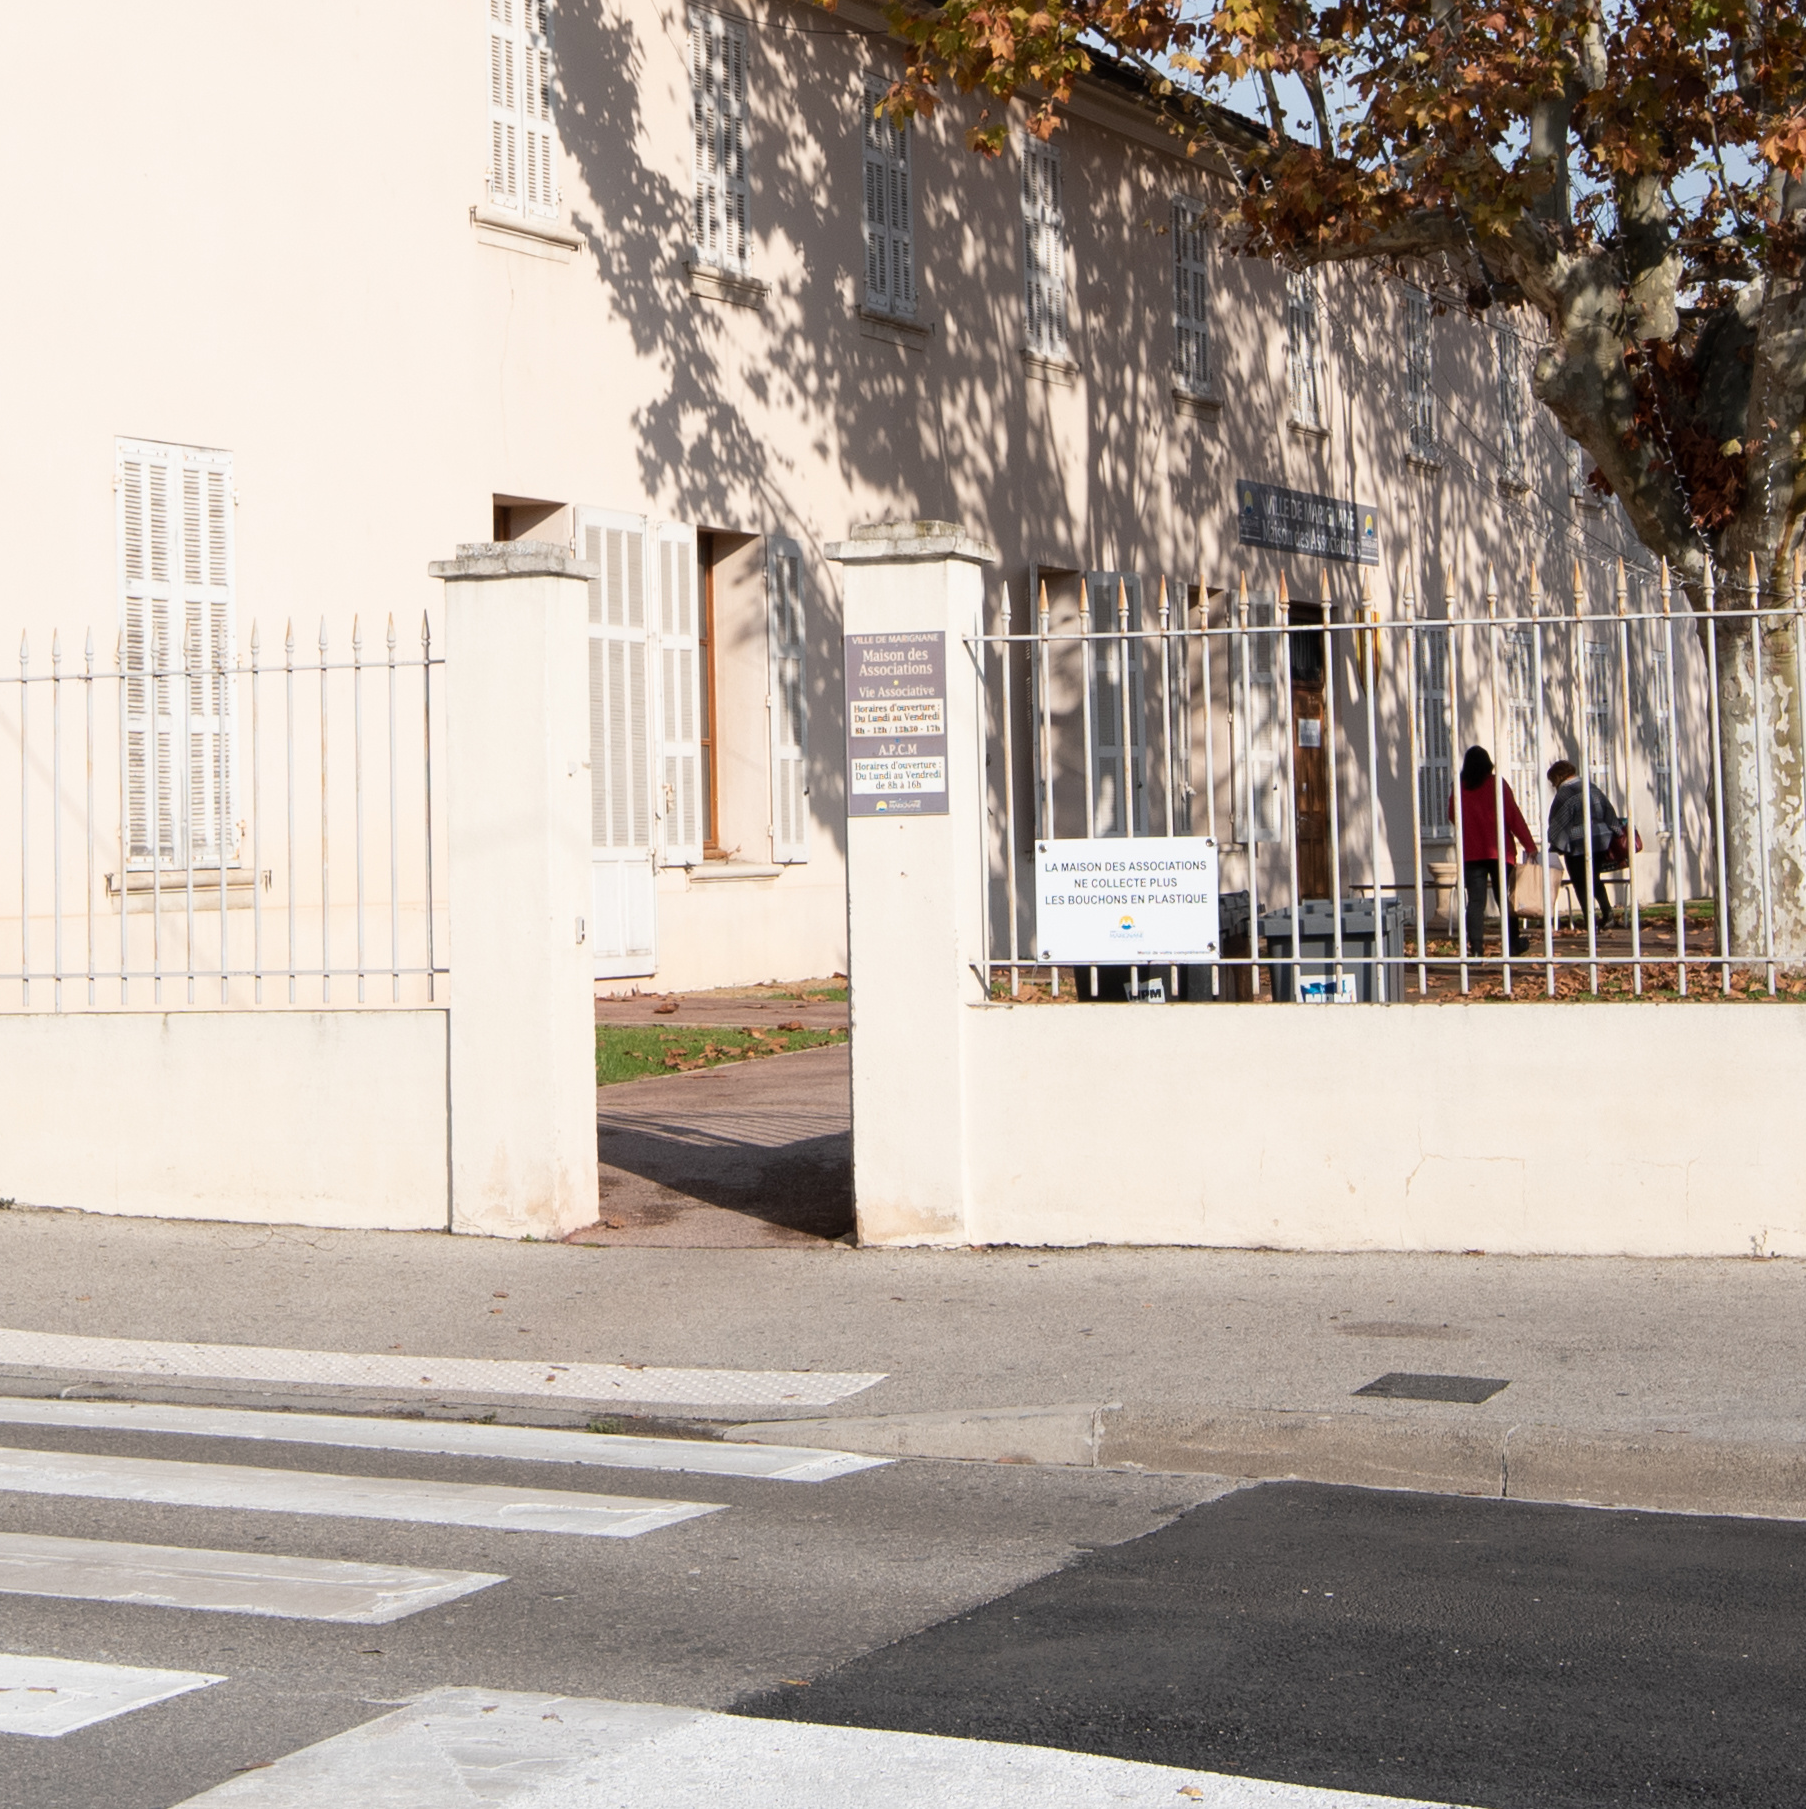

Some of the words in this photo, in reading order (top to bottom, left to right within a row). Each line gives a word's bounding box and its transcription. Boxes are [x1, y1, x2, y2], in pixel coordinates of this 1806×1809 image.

[852, 636, 874, 645] VILLE
[875, 635, 886, 644] DE
[888, 633, 939, 644] MARIGNANE
[862, 648, 905, 663] Maison
[907, 647, 929, 661] des
[858, 662, 933, 677] Associations
[859, 686, 875, 698] Vie
[877, 684, 935, 697] Associative
[854, 704, 888, 713] Horaires
[889, 703, 936, 712] d'ouverture
[854, 714, 866, 723] Du
[867, 713, 891, 723] Lundi
[904, 711, 940, 722] Vendredi
[878, 743, 918, 756] A.P.C.M
[855, 761, 889, 771] Horaires
[890, 760, 937, 770] d'ouverture
[855, 772, 867, 781] Du
[869, 771, 892, 780] Lundi
[905, 770, 942, 779] Vendredi
[875, 781, 886, 790] de
[907, 780, 922, 789] 16h
[1045, 863, 1059, 872] LA
[1061, 862, 1102, 872] MAISON
[1105, 862, 1126, 871] DES
[1128, 860, 1207, 871] ASSOCIATIONS
[1074, 878, 1088, 888] NE
[1091, 878, 1146, 888] COLLECTE
[1150, 877, 1178, 887] PLUS
[1045, 895, 1065, 905] LES
[1068, 894, 1128, 905] BOUCHONS
[1131, 894, 1145, 904] EN
[1148, 893, 1208, 904] PLASTIQUE
